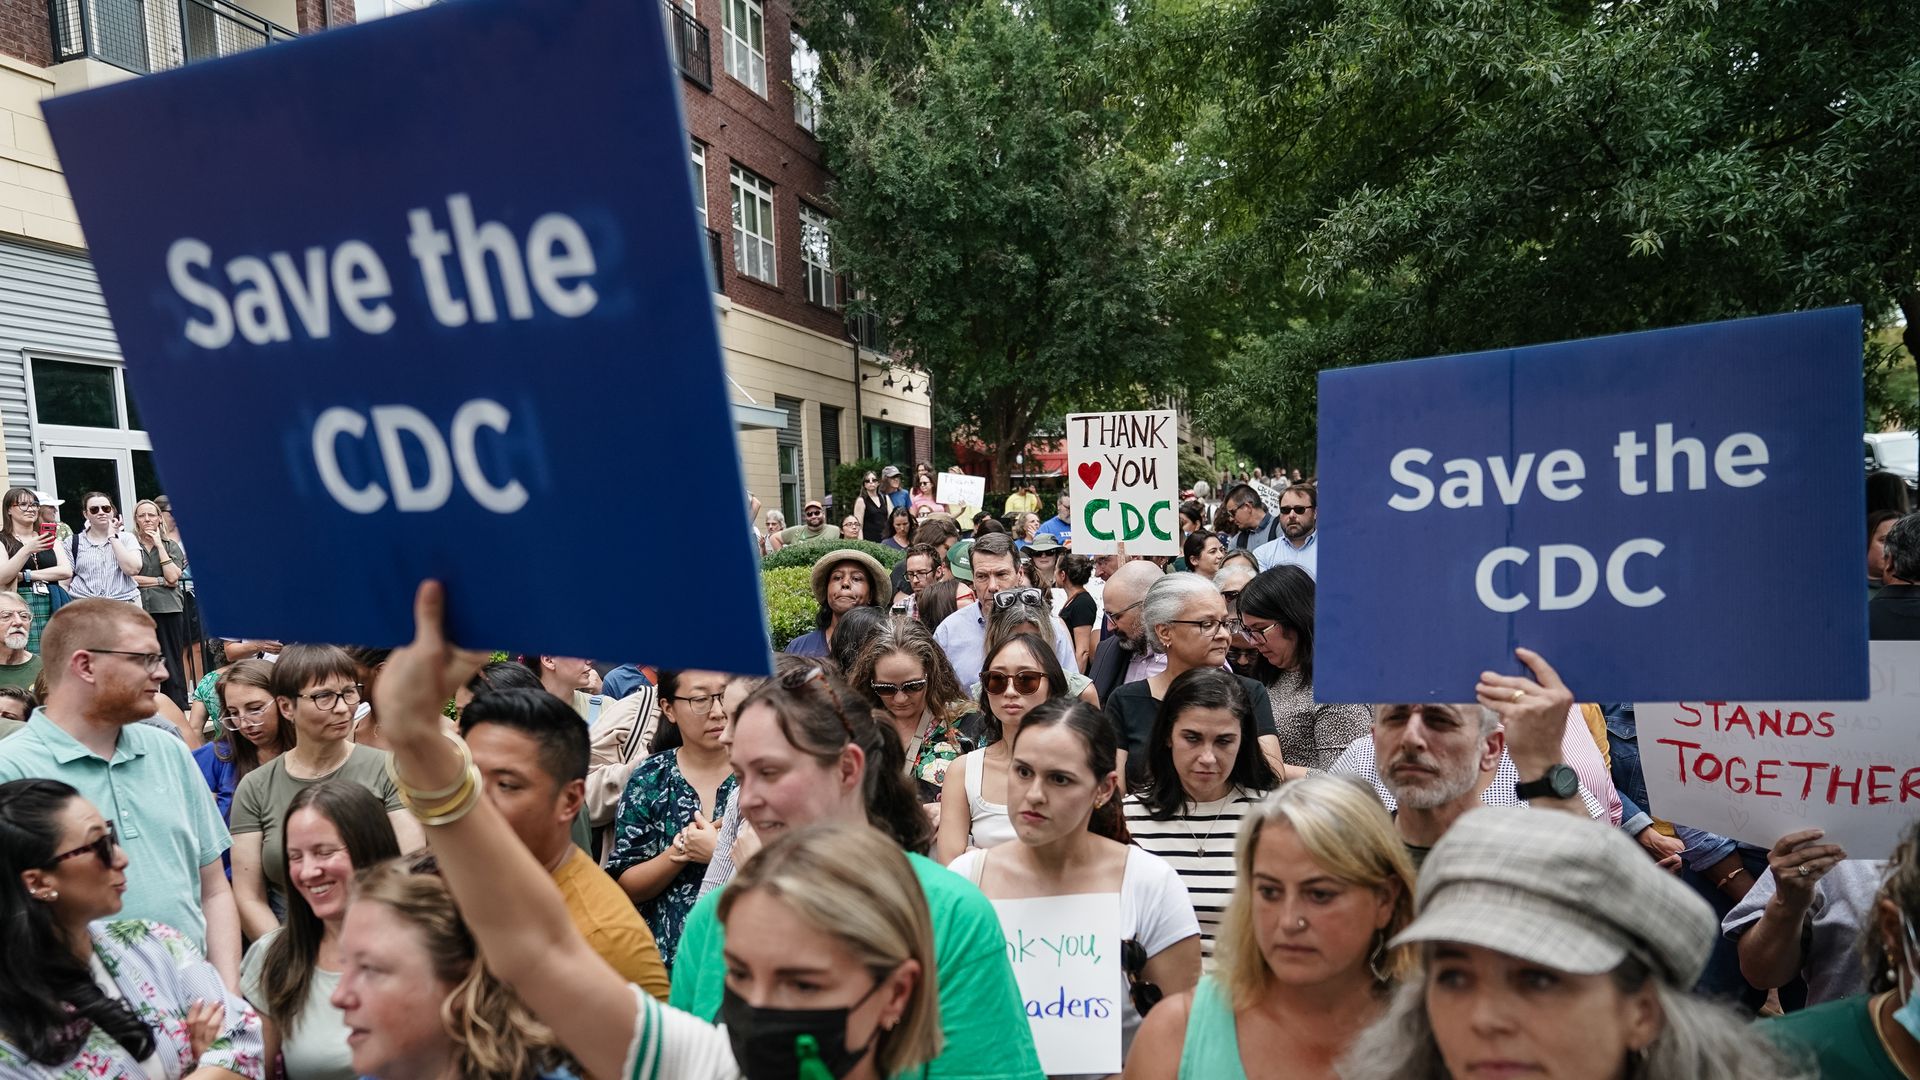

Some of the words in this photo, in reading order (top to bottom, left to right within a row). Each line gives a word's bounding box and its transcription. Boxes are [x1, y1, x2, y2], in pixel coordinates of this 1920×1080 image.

[167, 238, 395, 350] Save
[407, 193, 598, 327] the
[1071, 414, 1170, 449] THANK
[311, 398, 528, 513] CDC
[1104, 453, 1159, 492] YOU
[1387, 446, 1586, 512] Save
[1613, 423, 1770, 496] the
[1083, 498, 1173, 541] CDC
[1475, 537, 1667, 614] CDC
[1673, 700, 1836, 740] STANDS
[1656, 737, 1920, 805] TOGETHER
[1006, 929, 1036, 962] nk
[1025, 986, 1112, 1019] aders
